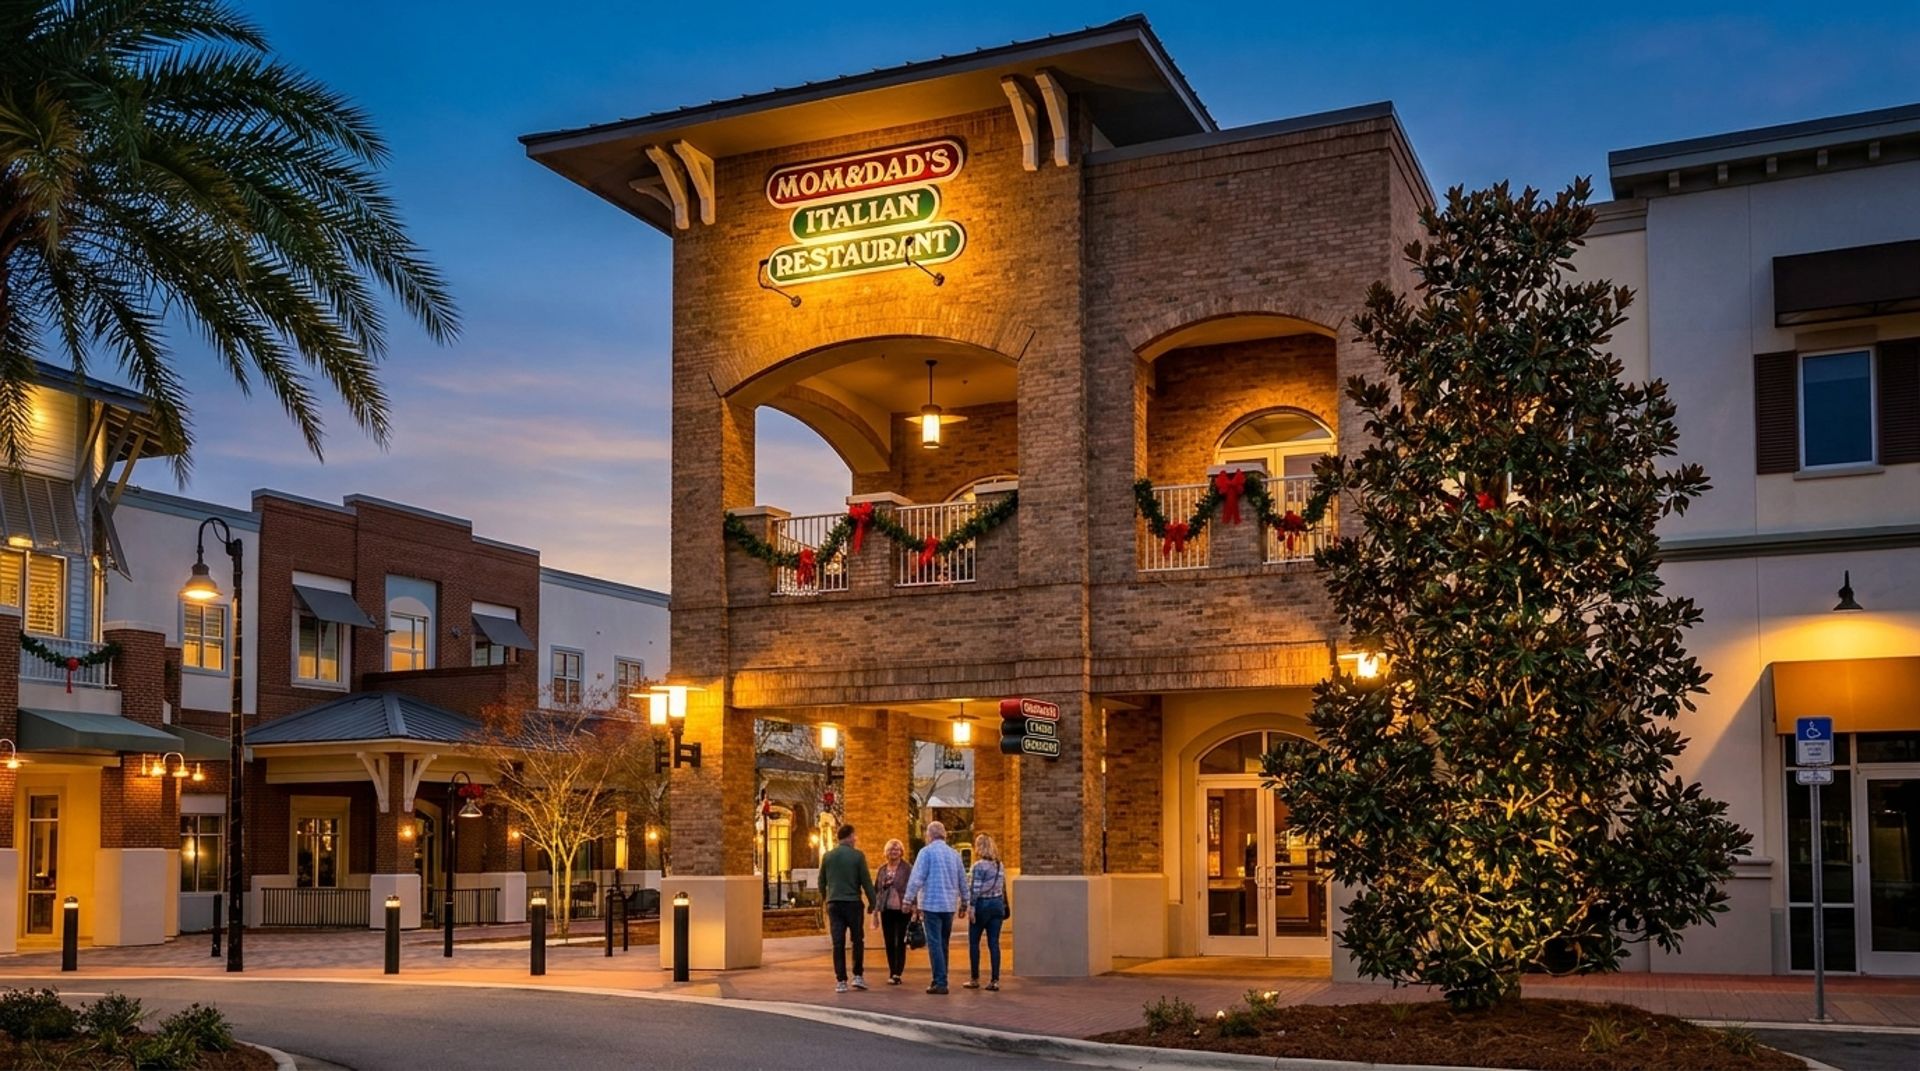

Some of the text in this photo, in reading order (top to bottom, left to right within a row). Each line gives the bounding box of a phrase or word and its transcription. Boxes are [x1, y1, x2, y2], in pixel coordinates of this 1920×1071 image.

[775, 148, 951, 199] MOM&DAD'S
[806, 193, 921, 234] ITALIAN
[775, 228, 951, 277] RESTAURANT
